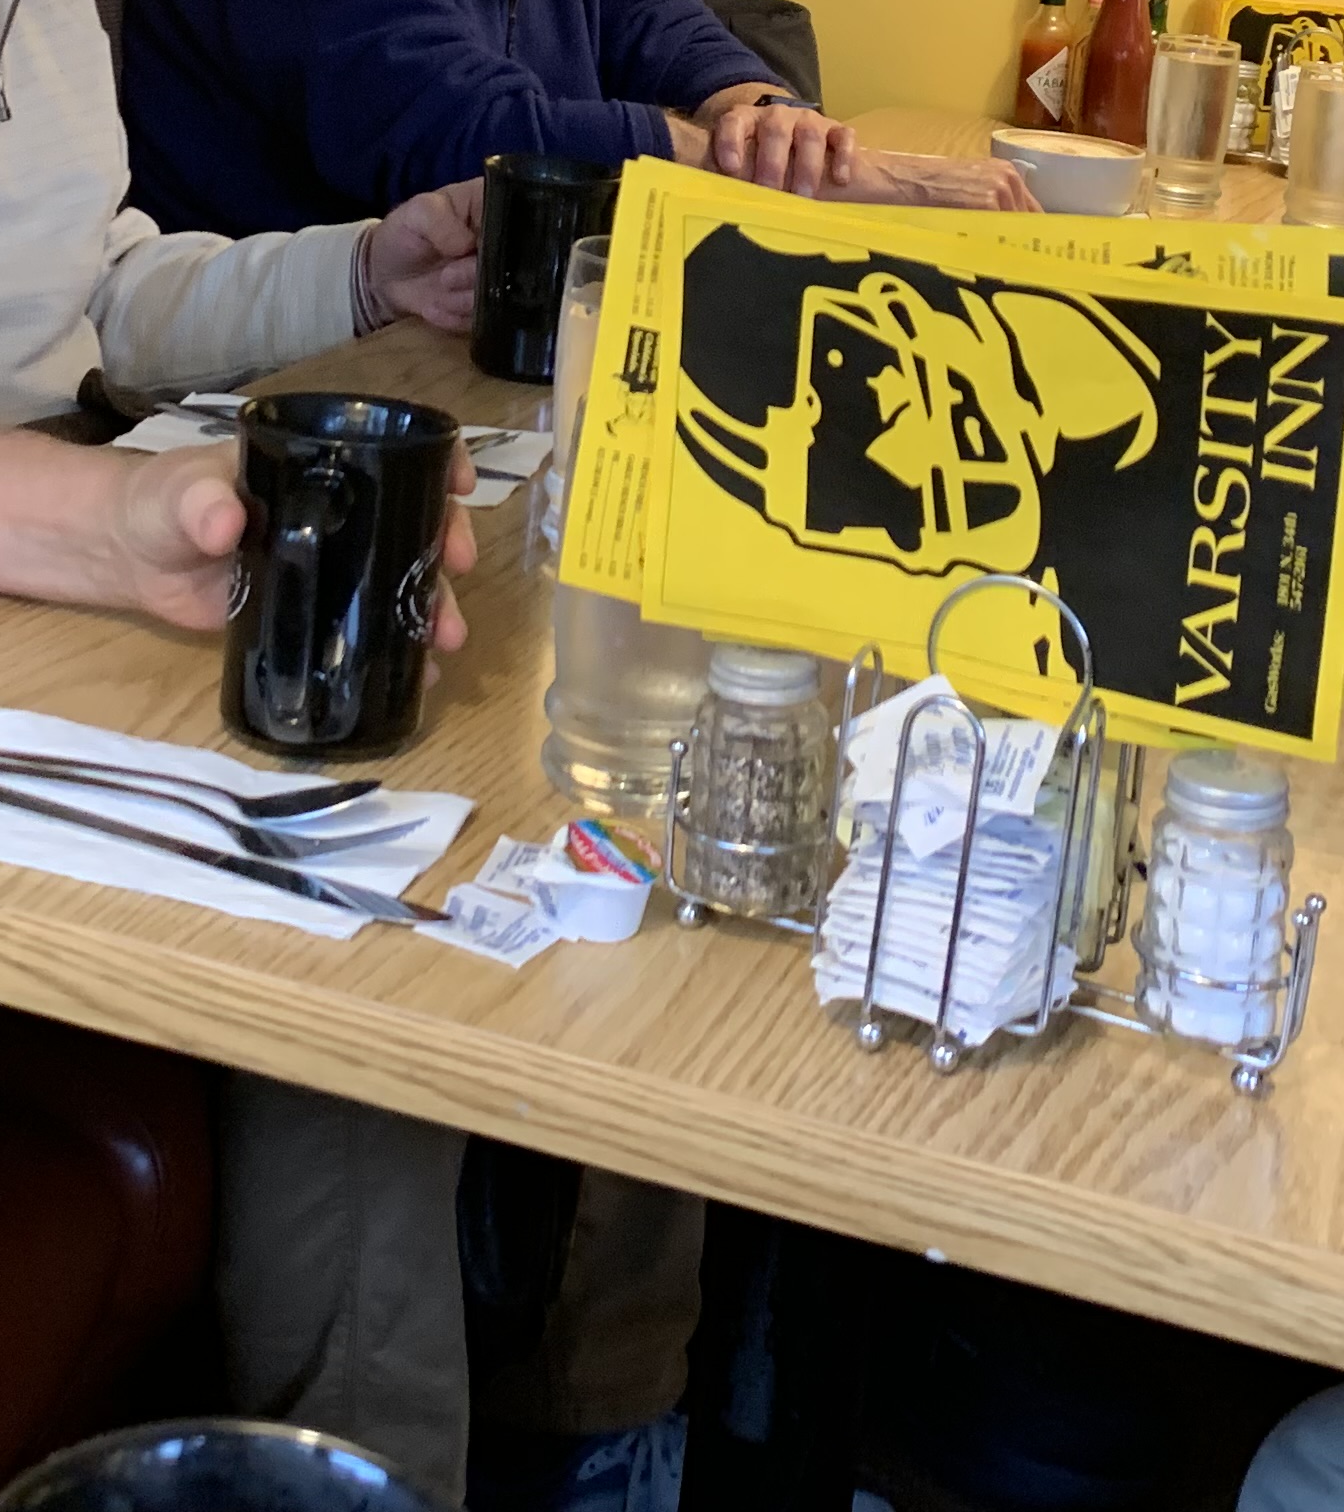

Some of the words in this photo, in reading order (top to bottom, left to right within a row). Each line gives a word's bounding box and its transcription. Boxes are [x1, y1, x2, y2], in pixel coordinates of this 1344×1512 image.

[1037, 75, 1065, 88] TABA
[1260, 322, 1330, 492] INN
[1174, 311, 1262, 706] VARSITY
